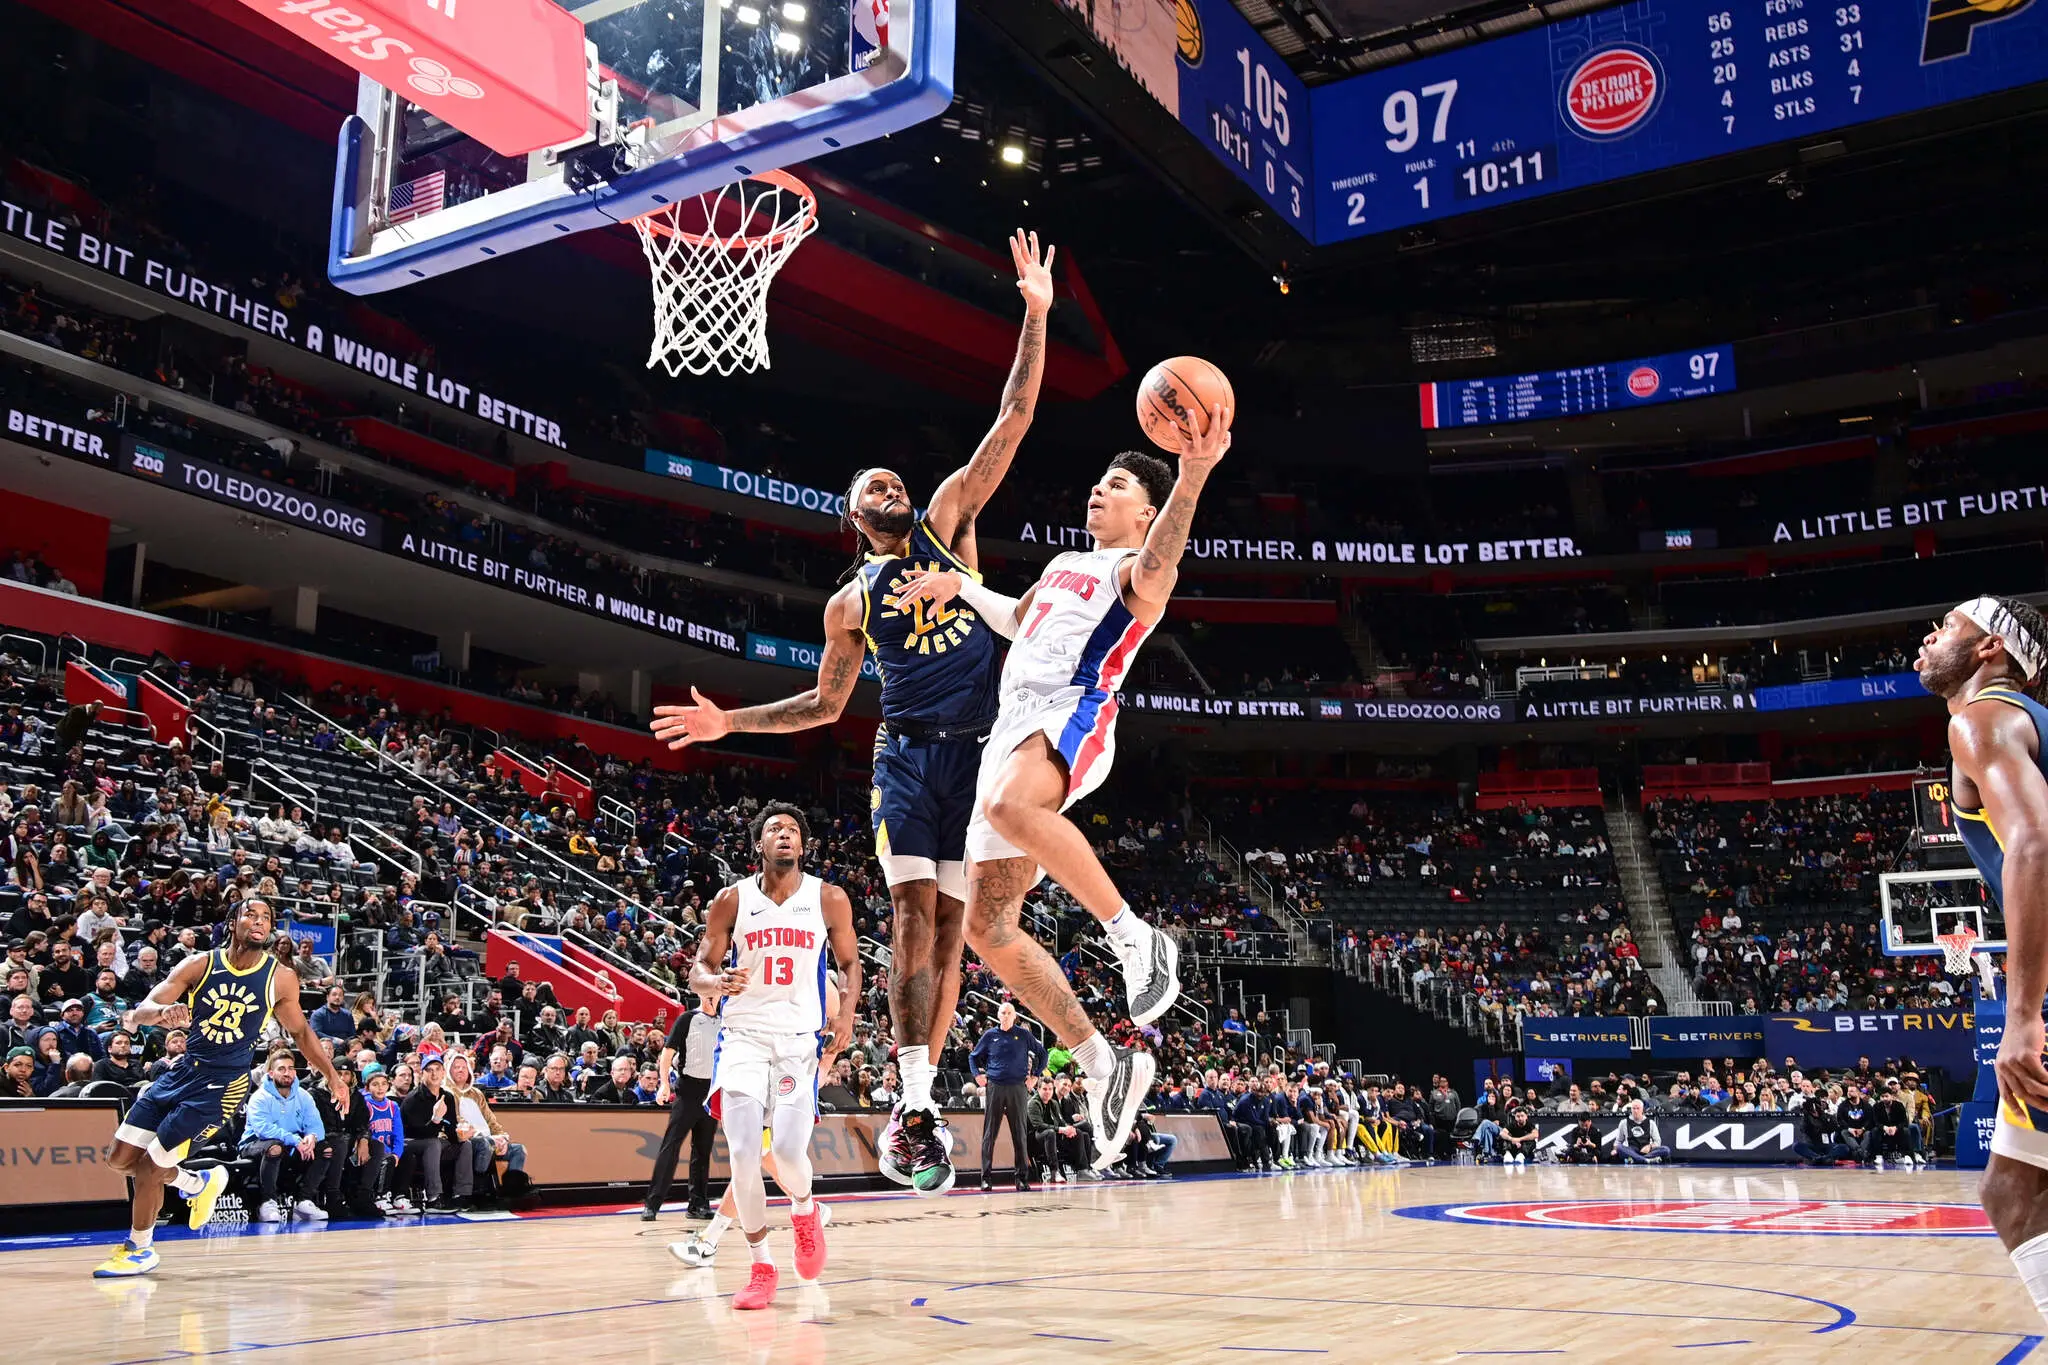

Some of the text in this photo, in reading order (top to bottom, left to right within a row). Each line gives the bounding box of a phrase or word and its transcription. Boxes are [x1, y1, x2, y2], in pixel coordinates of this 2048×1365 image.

[1708, 12, 1732, 33] 56
[1711, 4, 1861, 58] 25 REBS 33
[1713, 30, 1863, 85] 20 ASTS 31
[1236, 47, 1290, 147] 105
[1580, 69, 1642, 97] DETROIT
[1721, 58, 1860, 108] 4 BLKS 4
[1580, 84, 1644, 114] PISTONS
[1723, 85, 1862, 135] 7 STLS 7
[1382, 79, 1458, 153] 97
[1211, 111, 1250, 170] 10:11
[1456, 138, 1475, 159] 11
[1265, 160, 1275, 195] 0
[1404, 158, 1437, 174] FOULS:
[1462, 151, 1543, 196] 10:11
[1331, 172, 1378, 191] TIMEOUTS:
[1413, 176, 1430, 208] 1
[1290, 185, 1301, 218] 3
[1347, 192, 1366, 226] 2
[2, 200, 568, 450] TLE BIT FURTHER. A WHOLE LOT BETTER.
[1689, 351, 1720, 380] 97
[7, 408, 110, 460] BETTER.
[132, 452, 164, 474] ZOO
[668, 461, 693, 477] ZOO
[182, 463, 367, 537] TOLEDOZOO.ORG
[1020, 522, 1095, 548] A LITT
[1773, 522, 1793, 543] A
[1801, 507, 1893, 540] LITTLE
[1903, 499, 1948, 526] BIT
[1312, 541, 1326, 561] A
[1335, 541, 1416, 564] WHOLE
[1424, 543, 1469, 565] LOT
[1478, 536, 1583, 562] BETTER.
[1665, 535, 1693, 548] ZOO
[402, 533, 741, 653] A LITTLE BIT FURTHER. A WHOLE LOT BETTER.
[1037, 569, 1101, 602] STONS
[903, 608, 976, 656] PACERS
[1023, 602, 1053, 639] 7
[755, 643, 777, 658] ZOO
[1861, 680, 1897, 697] BLK
[1135, 693, 1145, 708] A
[1150, 695, 1200, 712] WHOLE
[1205, 700, 1232, 715] LOT
[1238, 701, 1304, 717] BETTER.
[1320, 705, 1342, 716] ZOO
[1354, 702, 1501, 720] TOLEDOZOO.ORG
[1526, 703, 1538, 718] A
[1543, 701, 1600, 717] LITTLE
[1606, 698, 1633, 714] BIT
[1639, 694, 1727, 713] FURTHER.
[1733, 694, 1744, 709] A
[744, 927, 816, 951] PISTONS
[763, 956, 794, 986] 13
[201, 982, 260, 1013] INDIANA
[208, 998, 246, 1030] 23
[1834, 1014, 1975, 1033] BETRIVE
[199, 1019, 245, 1045] PACERS
[1550, 1033, 1628, 1043] BETRIVERS
[1679, 1032, 1764, 1042] BETRIVERS
[1676, 1122, 1795, 1151] KIA
[210, 1209, 250, 1223] aesars
